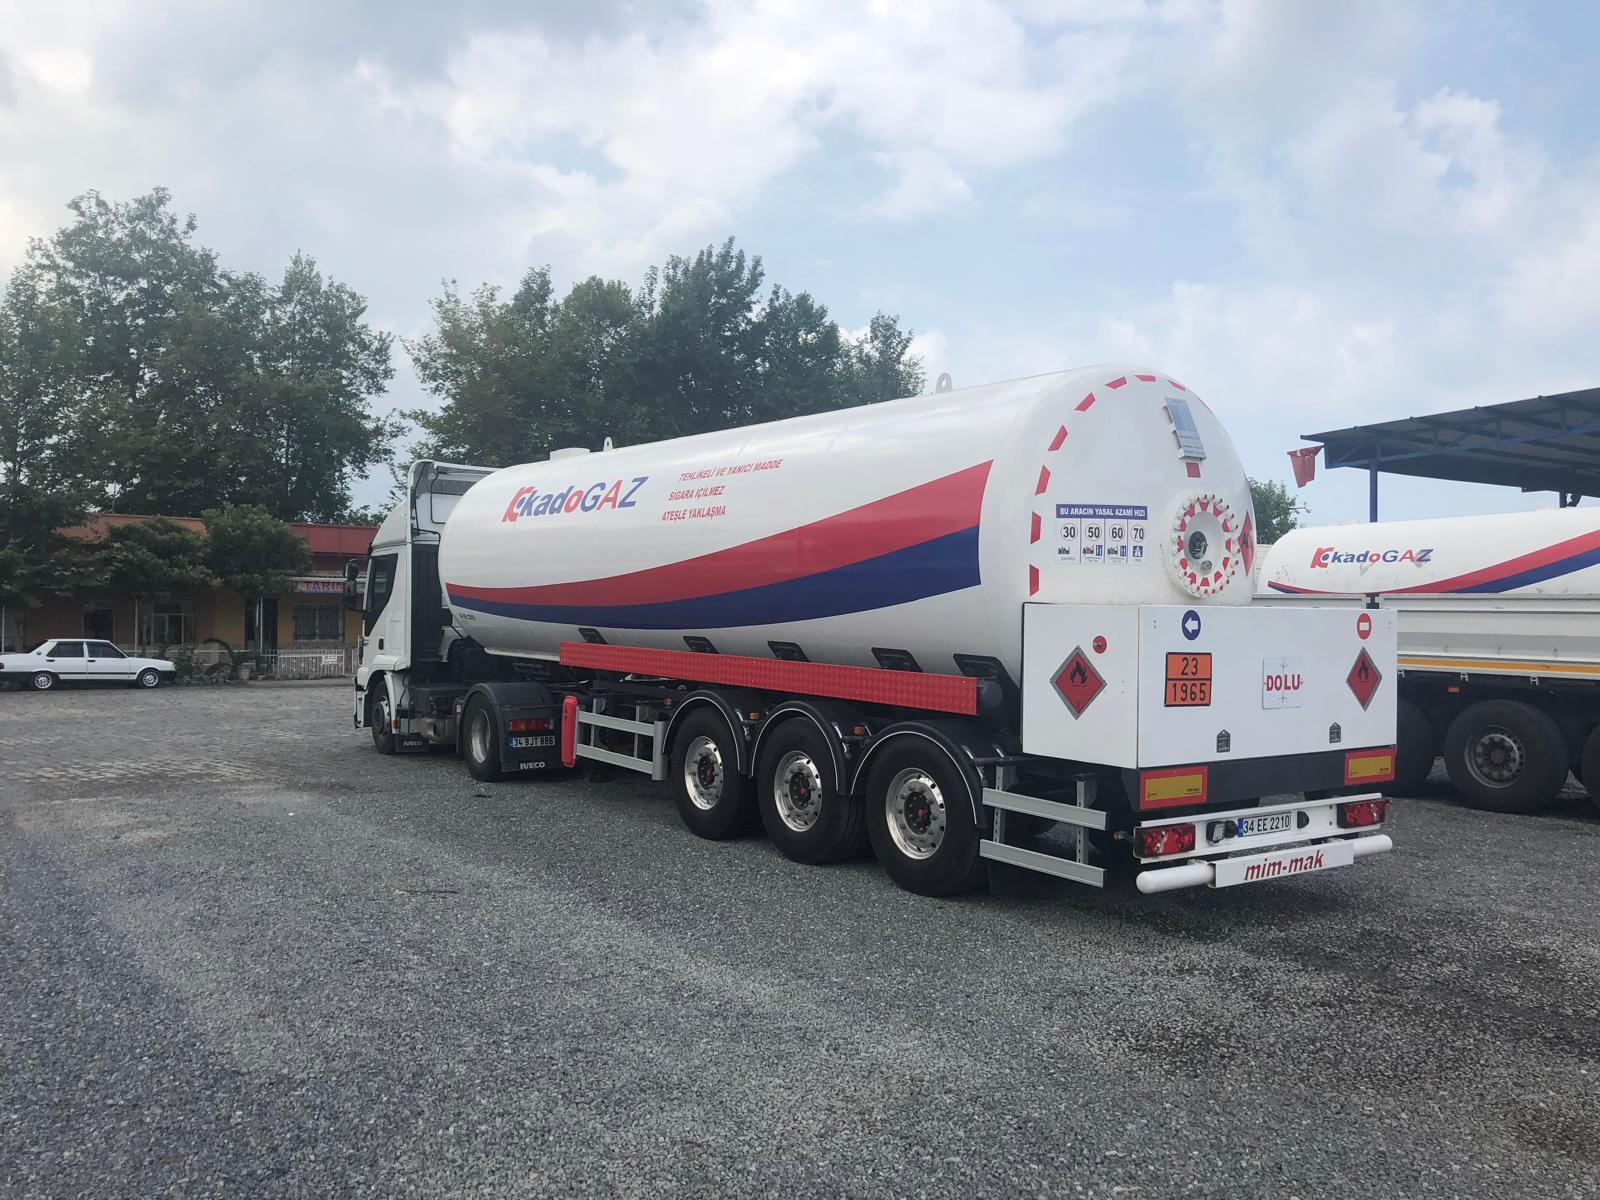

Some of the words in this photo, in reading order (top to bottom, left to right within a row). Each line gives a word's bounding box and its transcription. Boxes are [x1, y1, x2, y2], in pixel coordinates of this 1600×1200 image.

[716, 467, 727, 477] VE
[727, 464, 754, 475] YANICI
[753, 459, 783, 472] MADDE
[688, 505, 726, 519] YAKLAŞMA
[1060, 507, 1069, 515] BU
[1095, 508, 1114, 516] YASAL
[1134, 509, 1146, 517] HIZI
[1063, 526, 1076, 538] 30
[1088, 527, 1100, 538] 50
[1111, 527, 1124, 539] 60
[1133, 528, 1144, 539] 70
[1181, 657, 1199, 676] 23
[1266, 674, 1301, 691] DOLU
[1172, 683, 1206, 702] 1965
[513, 738, 523, 747] 34
[520, 761, 545, 770] IVECO
[1243, 820, 1254, 834] 34
[1257, 818, 1268, 832] EE
[1270, 815, 1290, 830] 2210
[1244, 850, 1324, 881] mim-mak
